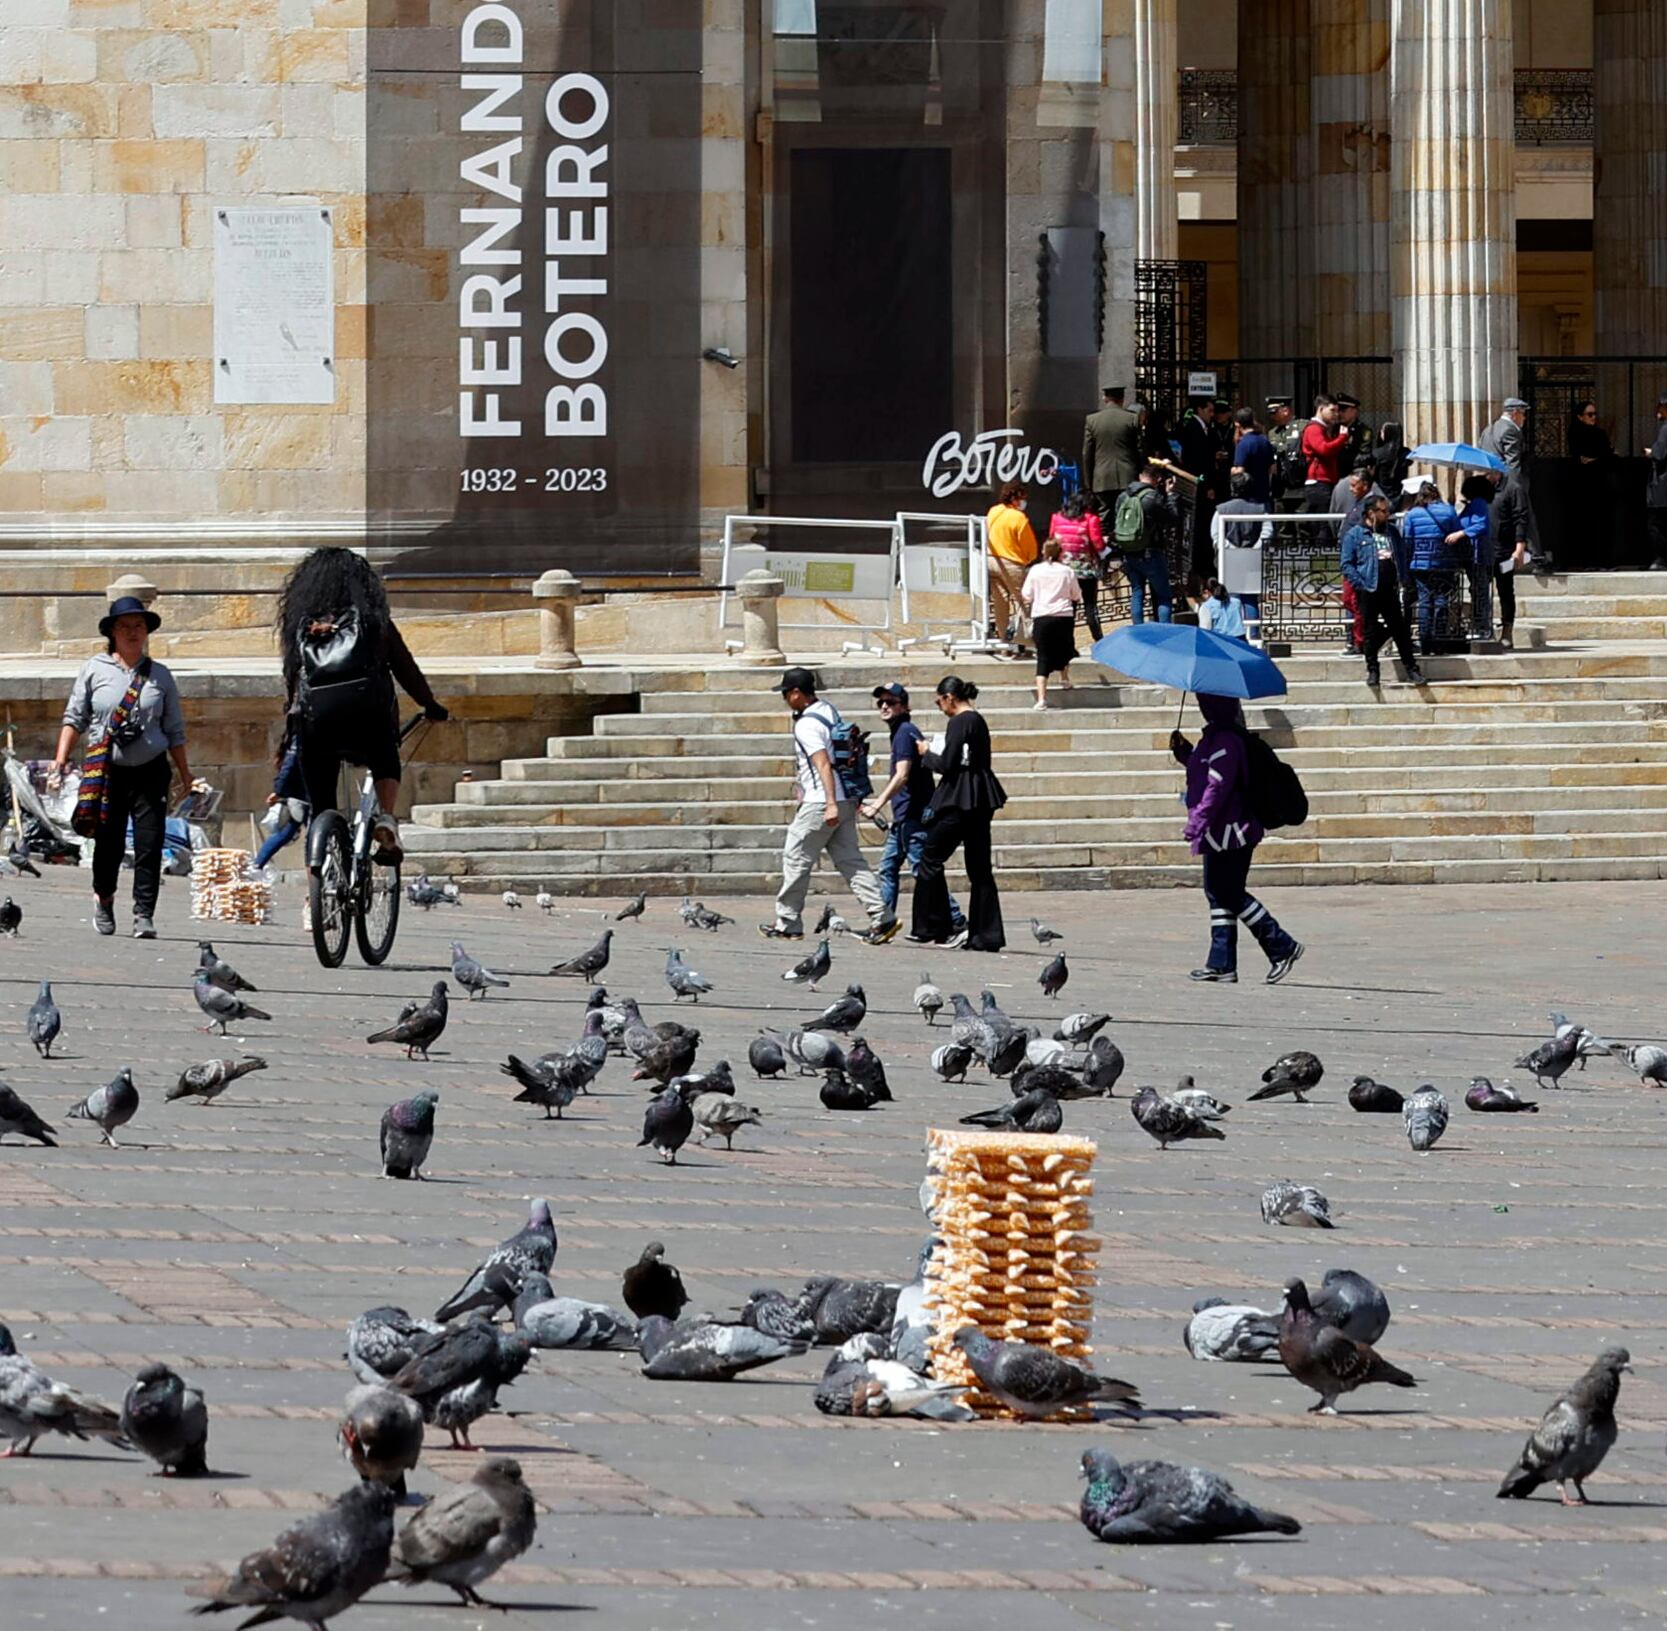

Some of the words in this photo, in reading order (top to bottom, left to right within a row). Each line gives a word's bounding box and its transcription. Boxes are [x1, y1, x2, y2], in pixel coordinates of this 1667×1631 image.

[544, 73, 608, 436] BOTERO
[460, 468, 517, 492] 1932
[545, 468, 608, 492] 2023
[922, 428, 1058, 498] Botero
